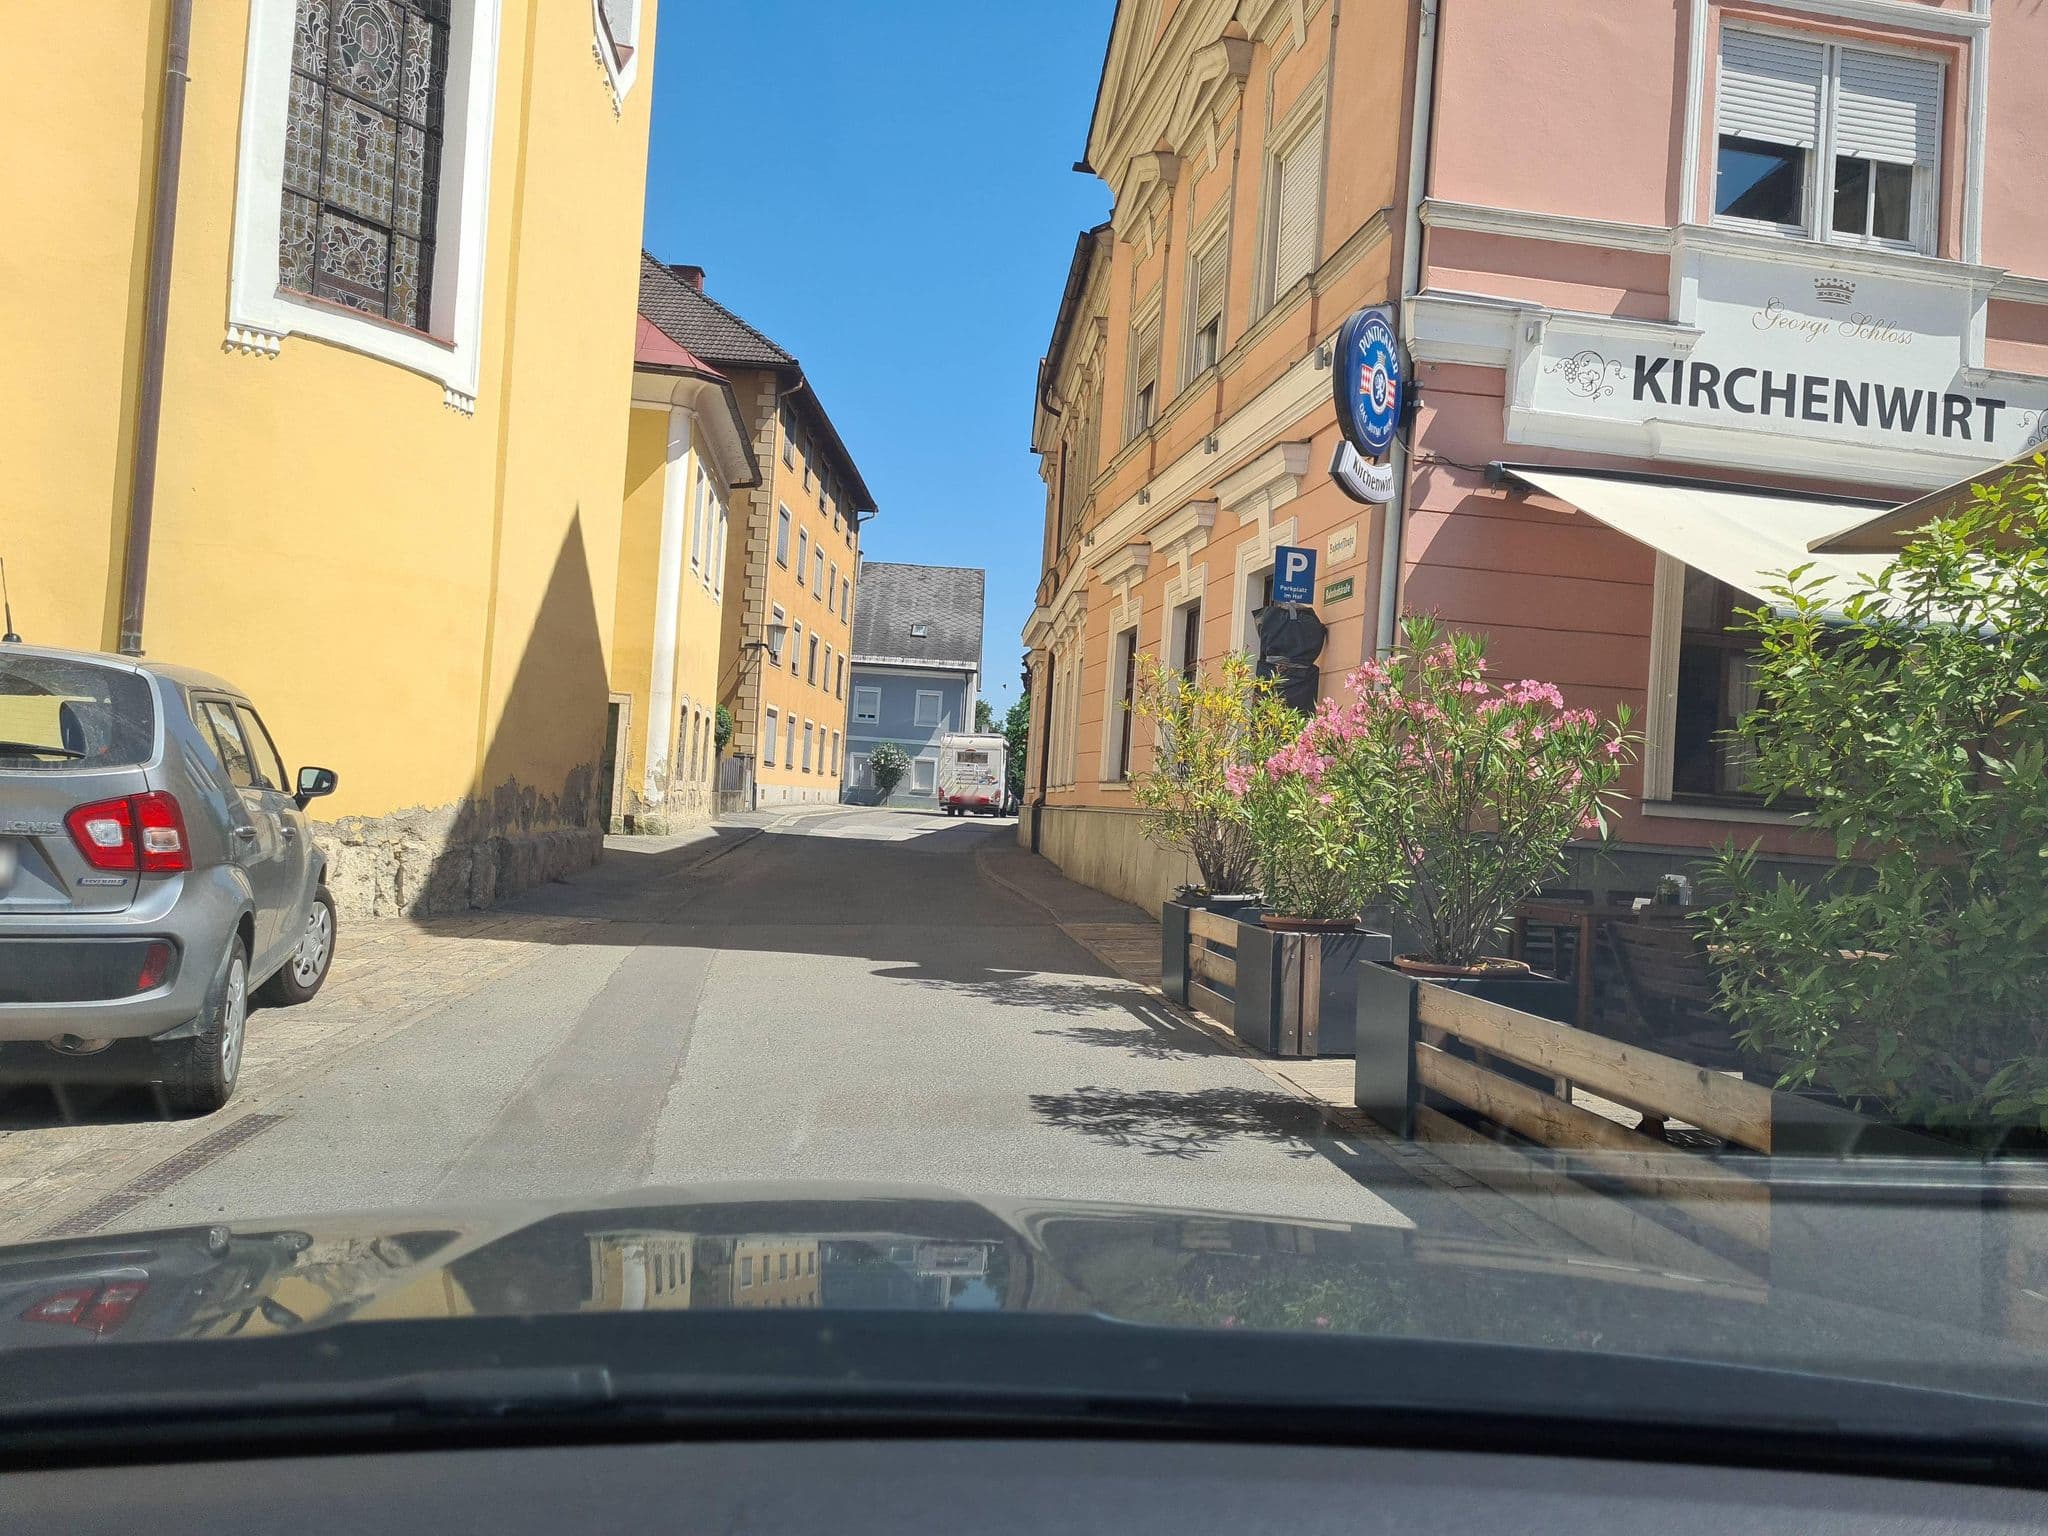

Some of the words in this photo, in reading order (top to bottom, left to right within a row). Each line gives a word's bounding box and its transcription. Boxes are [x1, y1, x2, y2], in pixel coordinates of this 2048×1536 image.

[1752, 296, 1834, 343] Georgi
[1838, 311, 1914, 345] Schloss
[1358, 325, 1399, 375] PUNTIGAMER
[1632, 354, 2007, 443] KIRCHENWIRT
[1280, 585, 1308, 593] Parkplatz
[1286, 552, 1308, 582] P
